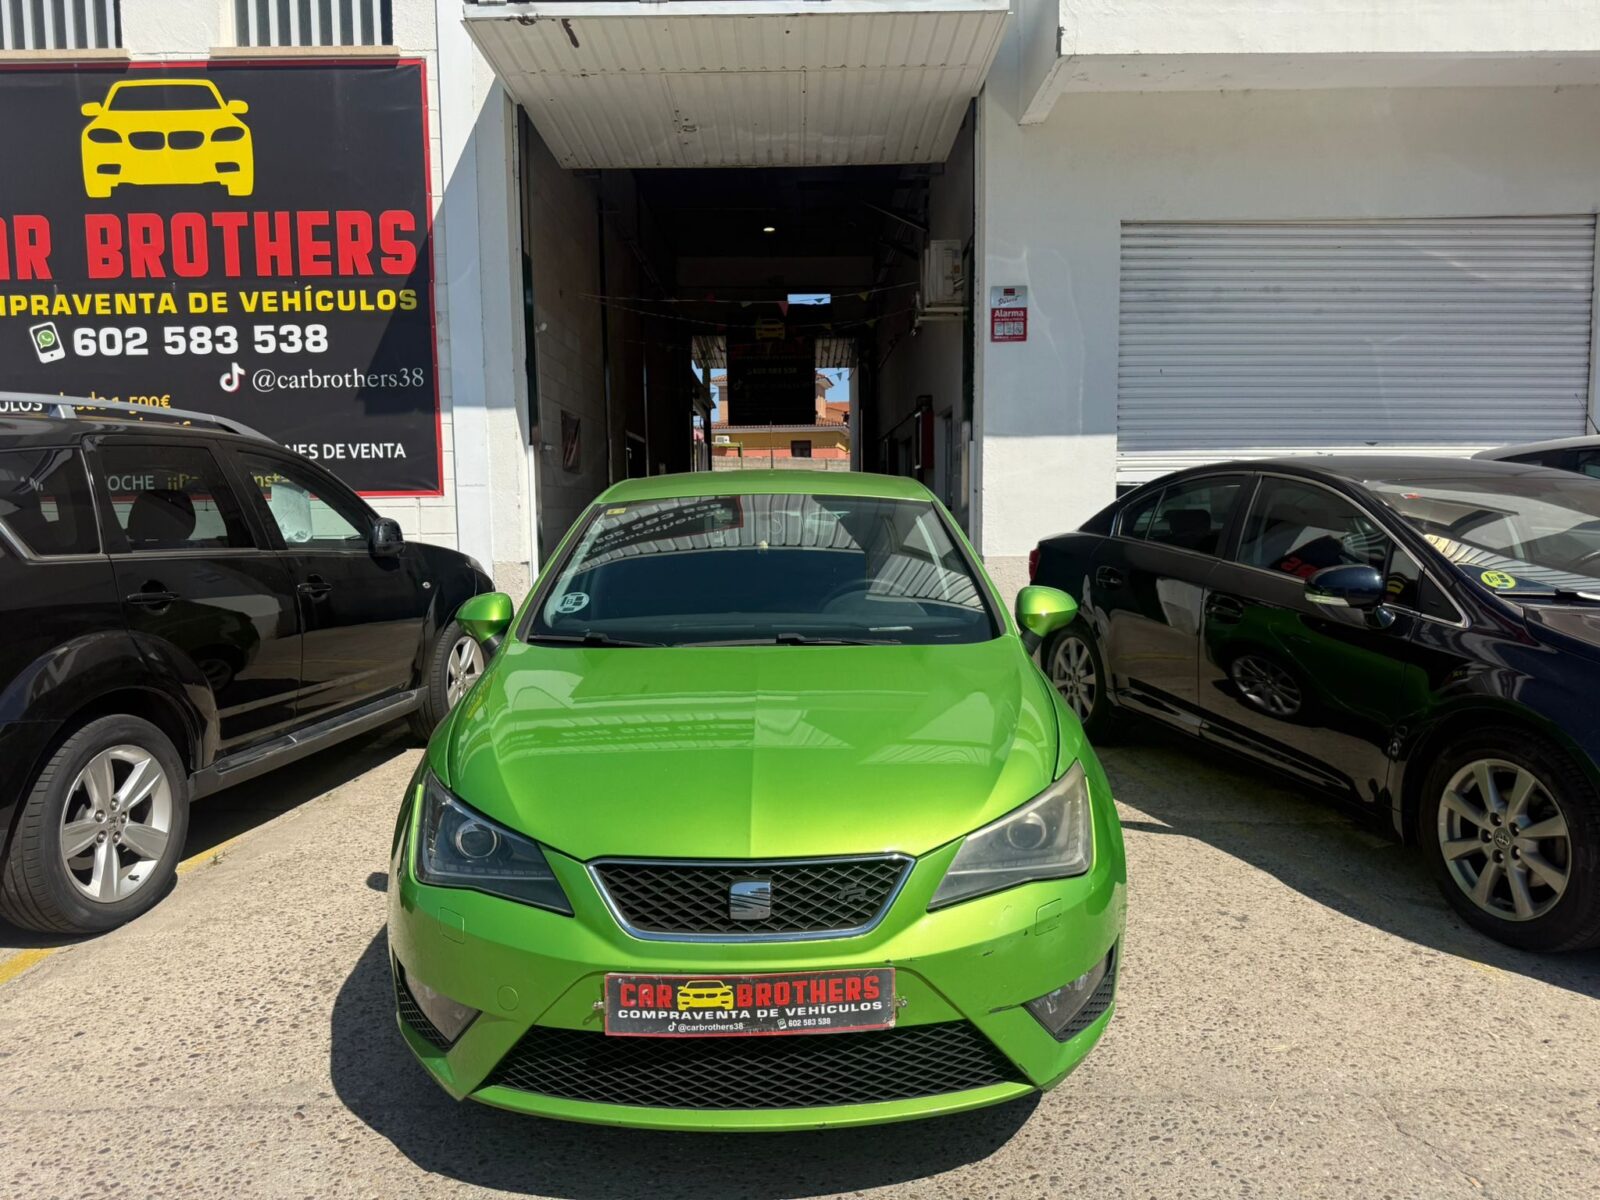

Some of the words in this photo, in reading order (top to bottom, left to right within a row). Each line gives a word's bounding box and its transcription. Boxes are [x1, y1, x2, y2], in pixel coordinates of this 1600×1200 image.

[0, 214, 53, 280] R
[84, 209, 417, 279] BROTHERS
[189, 291, 229, 314] DE
[240, 285, 417, 314] VEHÍCULOS
[993, 309, 1025, 318] Alarma
[73, 327, 149, 357] 602
[163, 325, 239, 355] 583
[253, 323, 329, 354] 538
[252, 367, 424, 393] @carbrothers38
[323, 443, 346, 459] DE
[348, 442, 407, 459] VENTA
[104, 475, 155, 491] OCHE
[620, 983, 673, 1008] CAR
[737, 975, 880, 1008] BROTHERS
[617, 1009, 751, 1021] COMPRAVENTA
[756, 1007, 779, 1019] DE
[785, 1000, 882, 1017] VEHÍCULOS
[678, 1022, 744, 1033] @carbrothers38
[788, 1018, 802, 1027] 602
[818, 1016, 831, 1025] 538
